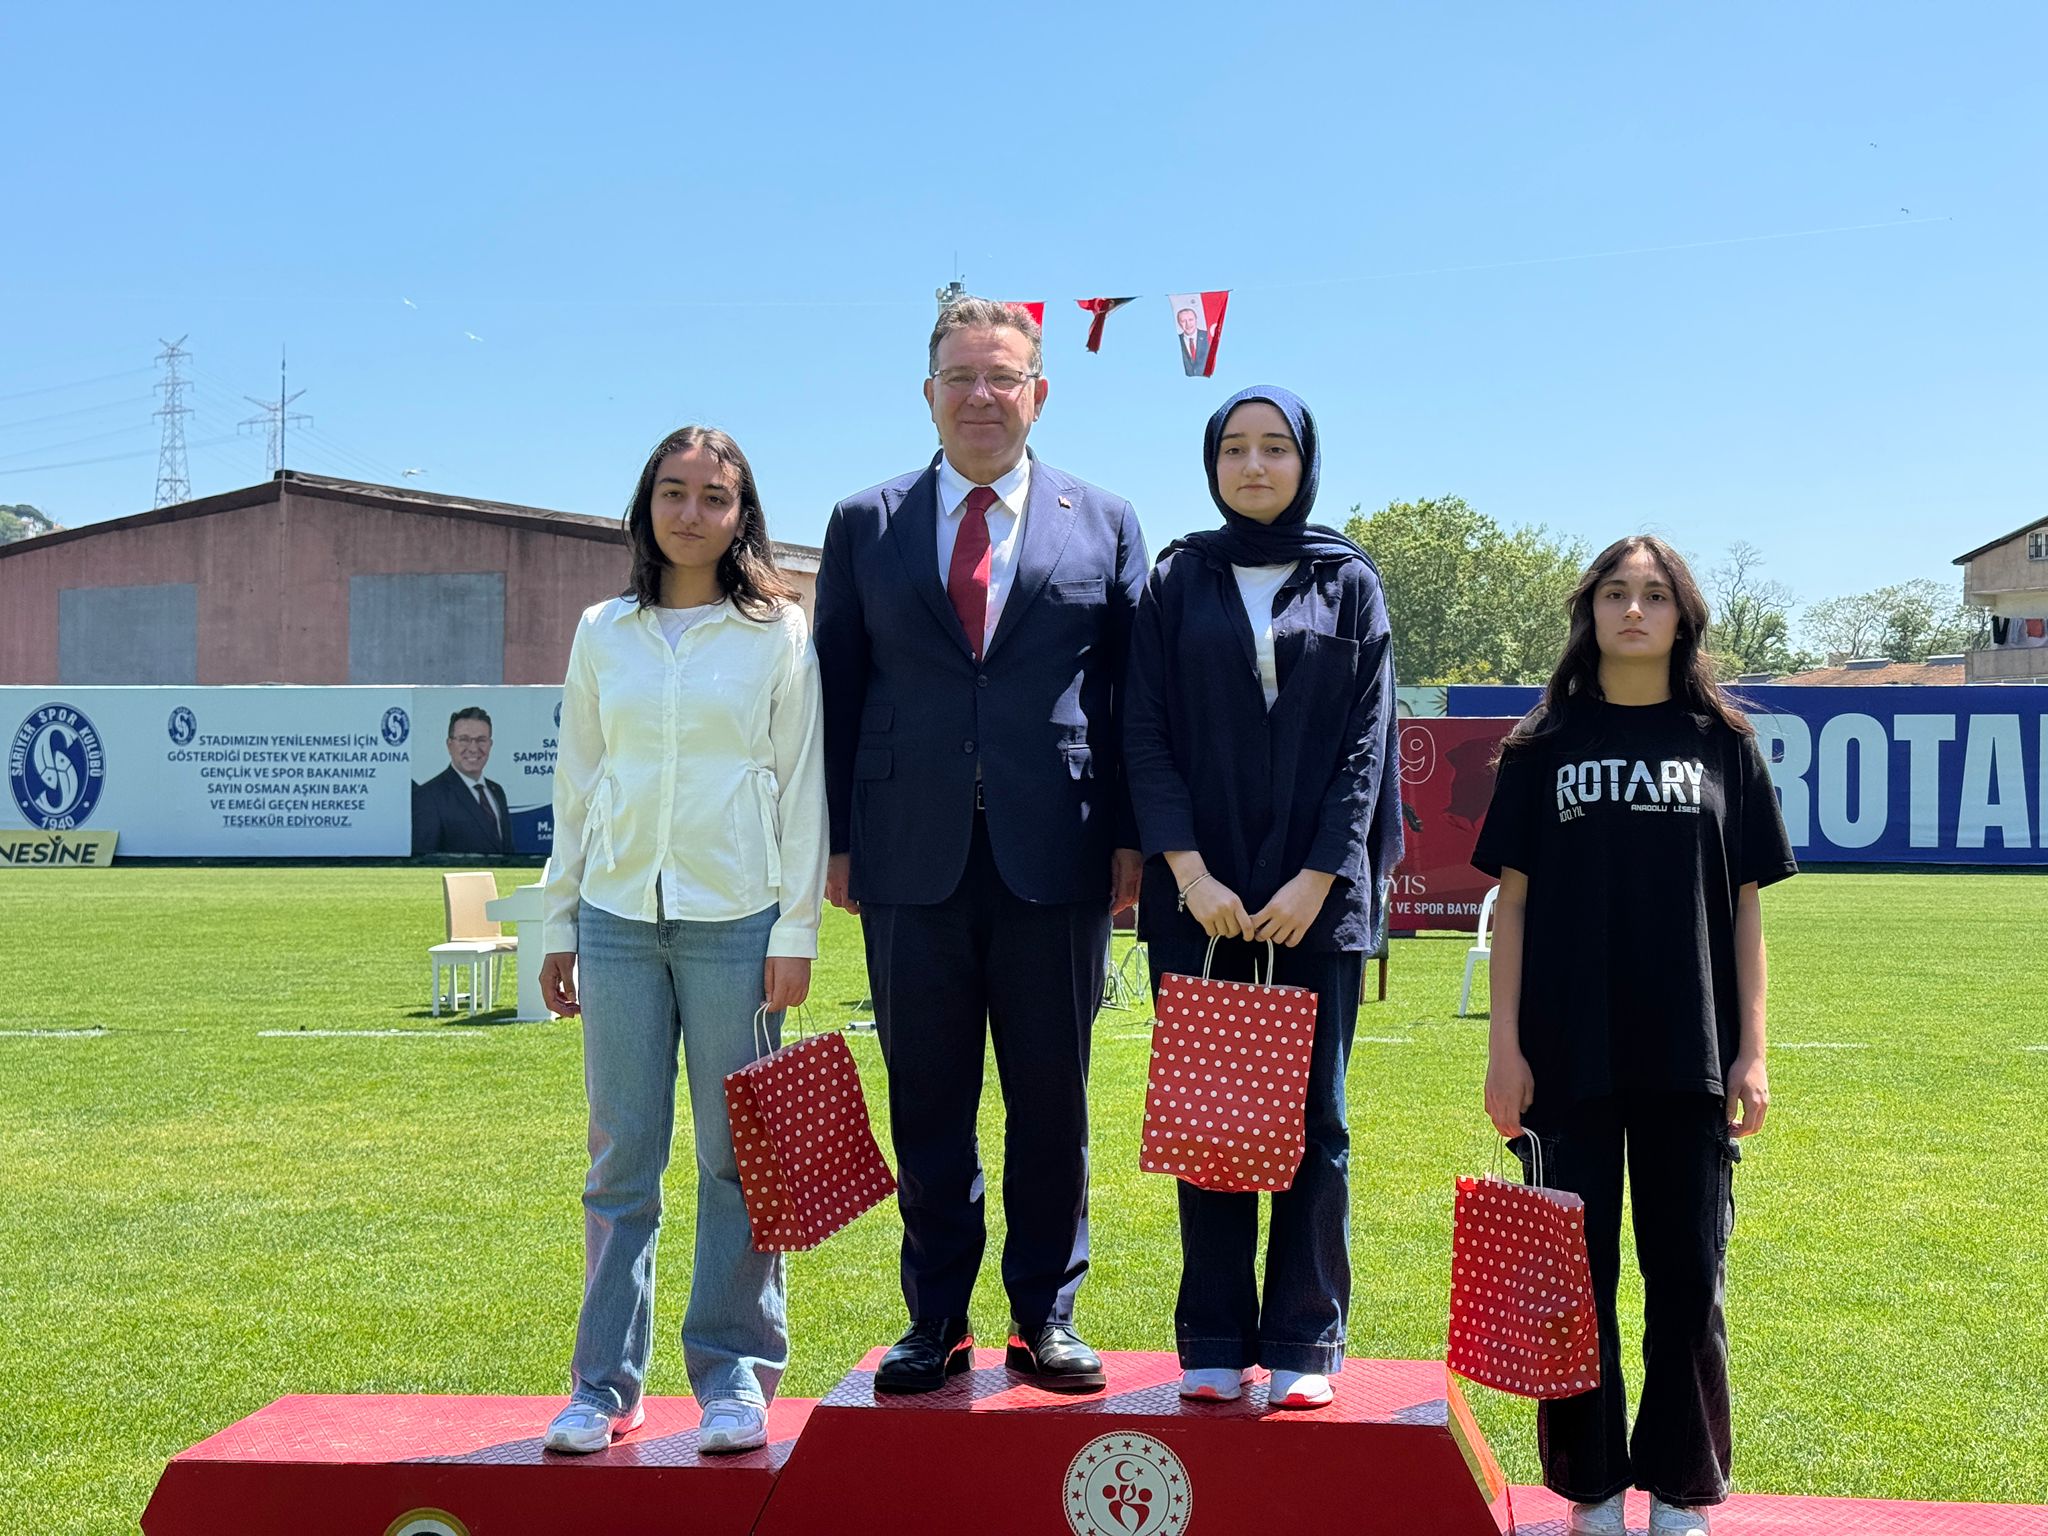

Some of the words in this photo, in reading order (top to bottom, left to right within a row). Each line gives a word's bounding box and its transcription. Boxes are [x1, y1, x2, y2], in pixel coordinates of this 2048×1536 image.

[11, 723, 36, 777] SARIYER
[38, 708, 78, 727] SPOR
[199, 735, 268, 746] STADIMIZIN
[271, 733, 351, 747] YENİLENMESİ
[353, 733, 378, 749] İÇİN
[167, 749, 240, 762] GÖSTERDİĞİ
[243, 751, 288, 762] DESTEK
[291, 752, 306, 762] VE
[309, 752, 368, 762] KATKILAR
[370, 752, 409, 762] ADINA
[200, 766, 251, 780] GENÇLİK
[253, 768, 269, 778] VE
[271, 767, 304, 778] SPOR
[307, 768, 376, 778] BAKANIMIZ
[1556, 759, 1704, 811] ROTARY
[1744, 712, 2048, 849] ROTA
[207, 783, 242, 794] SAYIN
[245, 783, 290, 794] OSMAN
[293, 784, 330, 797] AŞKIN
[210, 800, 225, 810] VE
[228, 798, 265, 810] EMEĞİ
[268, 799, 309, 813] GEÇEN
[311, 799, 365, 810] HERKESE
[1631, 804, 1668, 813] ANADOLU
[41, 816, 75, 831] 1940
[223, 814, 284, 828] TEŞEKKÜR
[287, 814, 352, 828] EDİYORUZ.
[1396, 902, 1411, 914] VE
[1414, 902, 1444, 915] SPOR
[1447, 902, 1494, 915] BAYR
